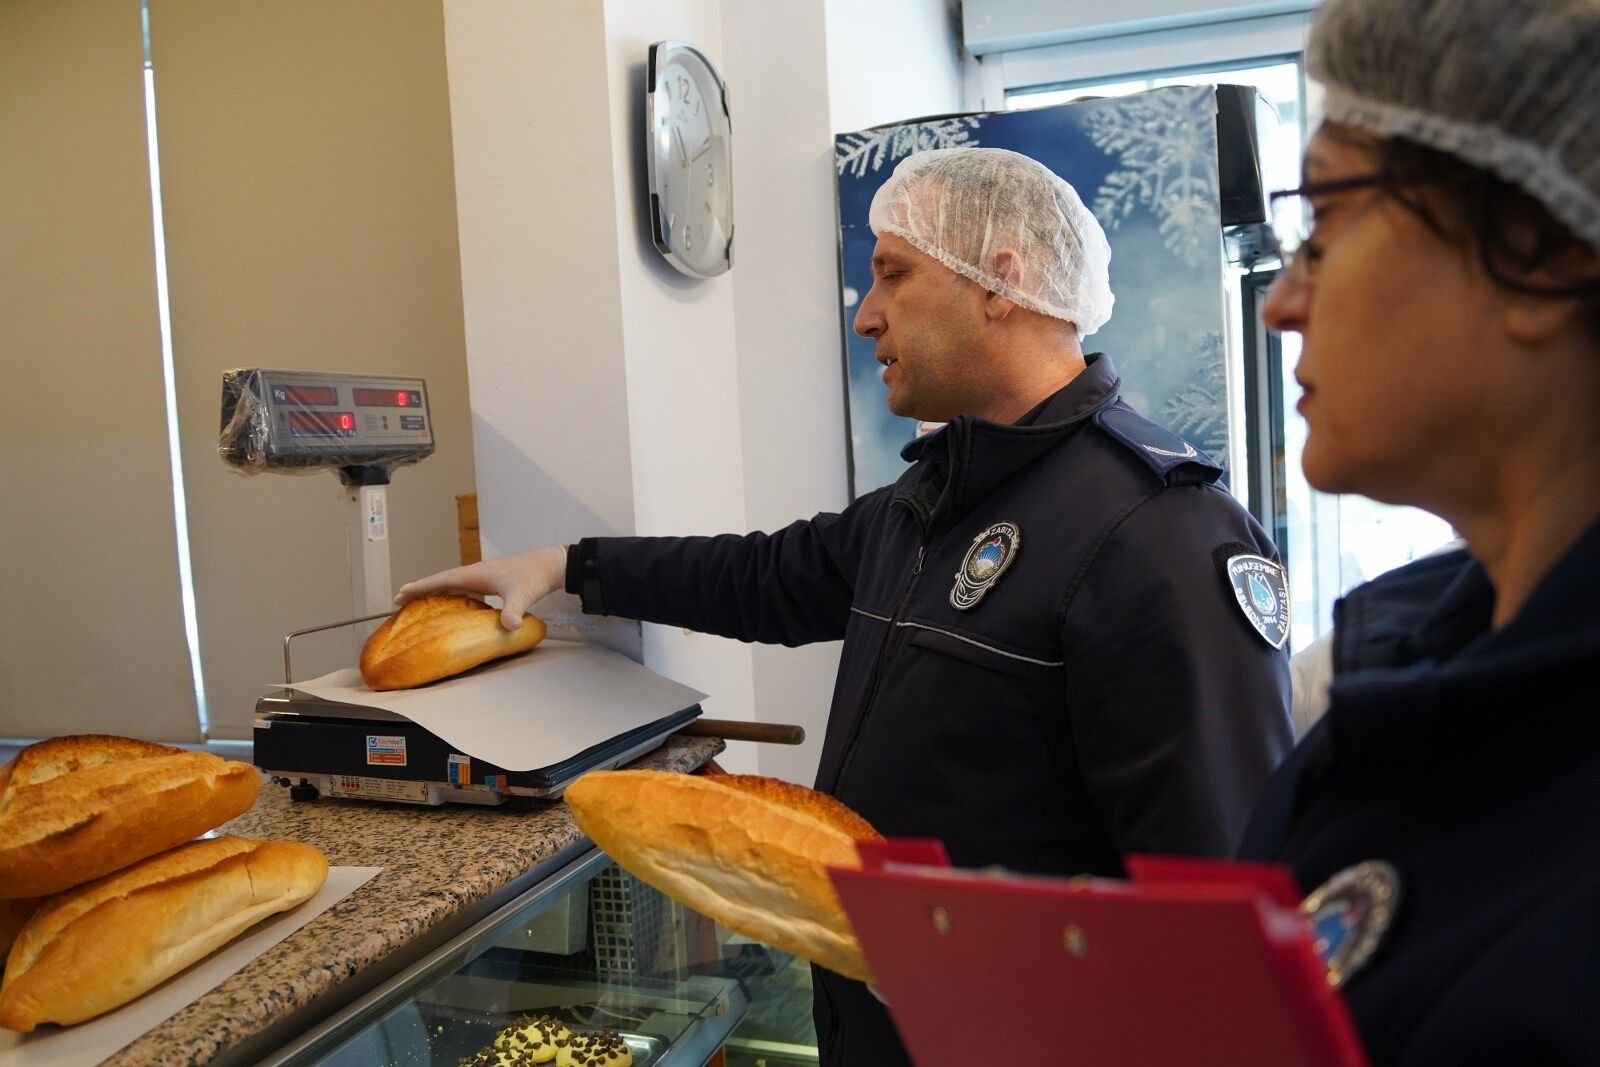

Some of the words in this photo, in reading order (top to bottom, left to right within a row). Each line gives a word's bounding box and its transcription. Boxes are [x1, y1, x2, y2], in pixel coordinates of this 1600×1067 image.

[678, 75, 690, 105] 12
[705, 163, 713, 187] 3
[683, 225, 692, 250] 6
[274, 389, 286, 400] Kg
[398, 391, 407, 406] 0
[341, 415, 348, 429] 0
